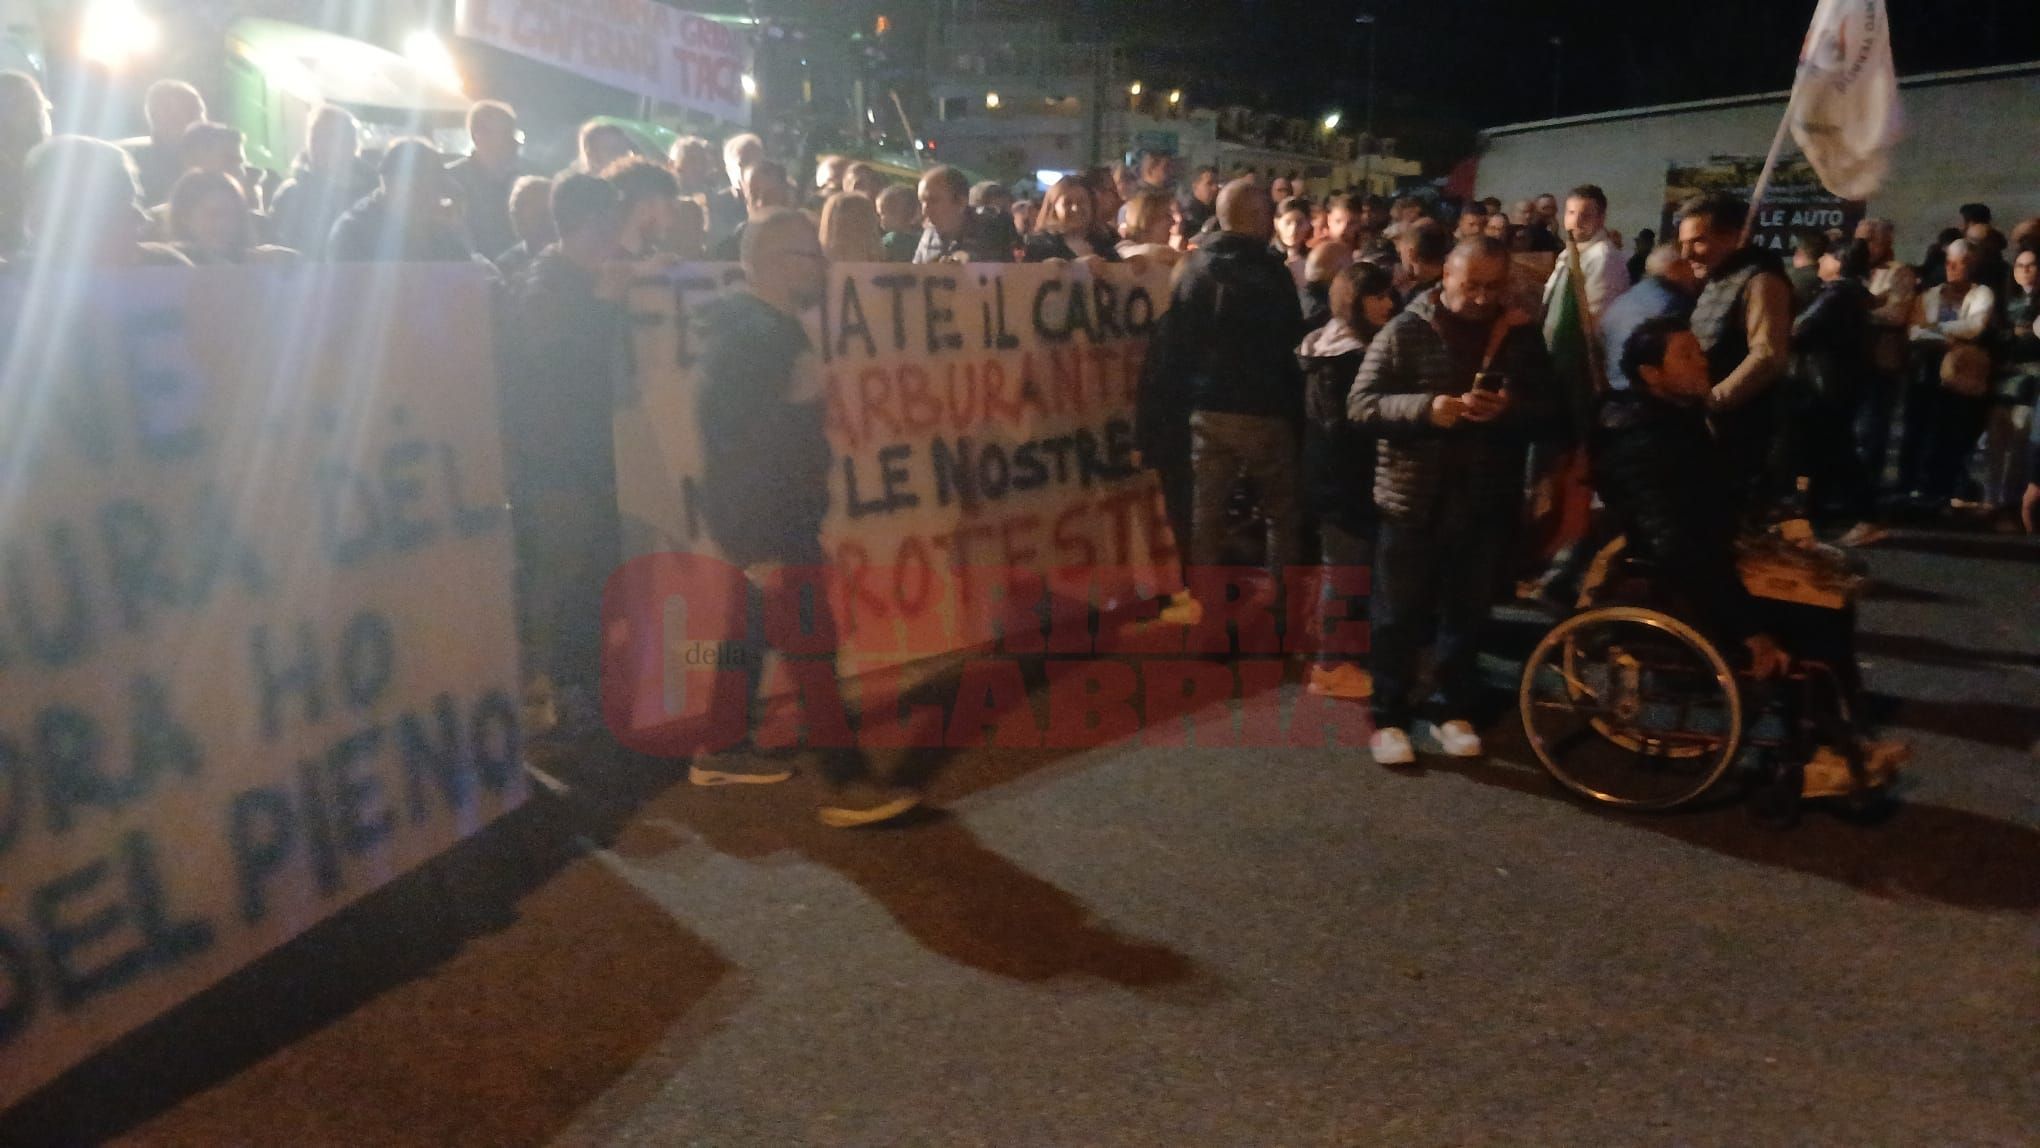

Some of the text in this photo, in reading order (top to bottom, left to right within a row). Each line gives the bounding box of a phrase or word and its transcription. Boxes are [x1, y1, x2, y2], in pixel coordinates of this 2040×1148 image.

[1760, 209, 1844, 227] LE AUTO
[1033, 279, 1153, 343] CARO
[931, 415, 1139, 514] NOSTRE
[248, 610, 396, 742] HO
[229, 689, 521, 925] PIENO
